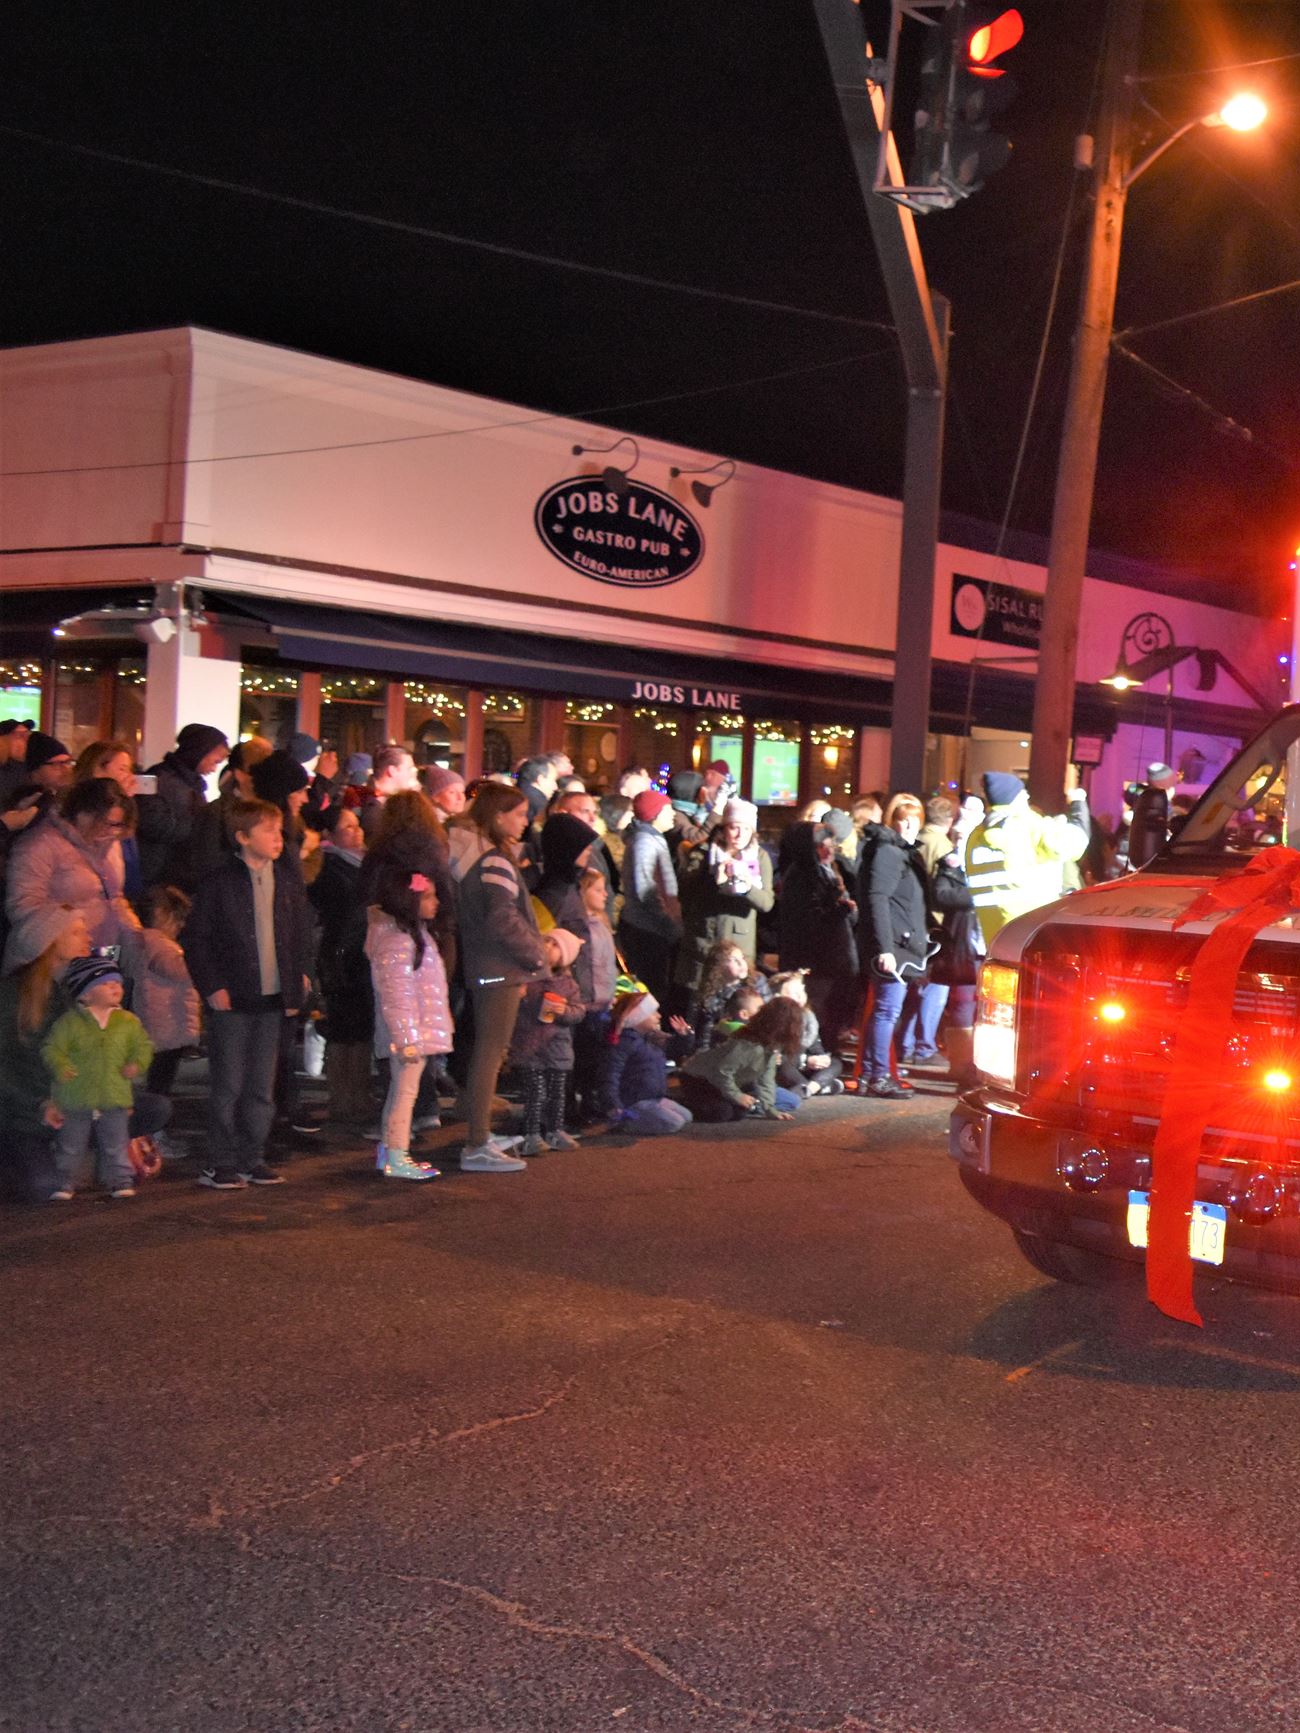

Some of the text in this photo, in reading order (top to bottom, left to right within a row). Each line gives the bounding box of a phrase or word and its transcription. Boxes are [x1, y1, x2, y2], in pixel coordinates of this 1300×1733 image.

[555, 491, 689, 542] JOBS LANE
[572, 526, 670, 557] GASTRO PUB
[573, 550, 669, 580] EURO-AMERICAN
[632, 681, 742, 711] JOBS LANE
